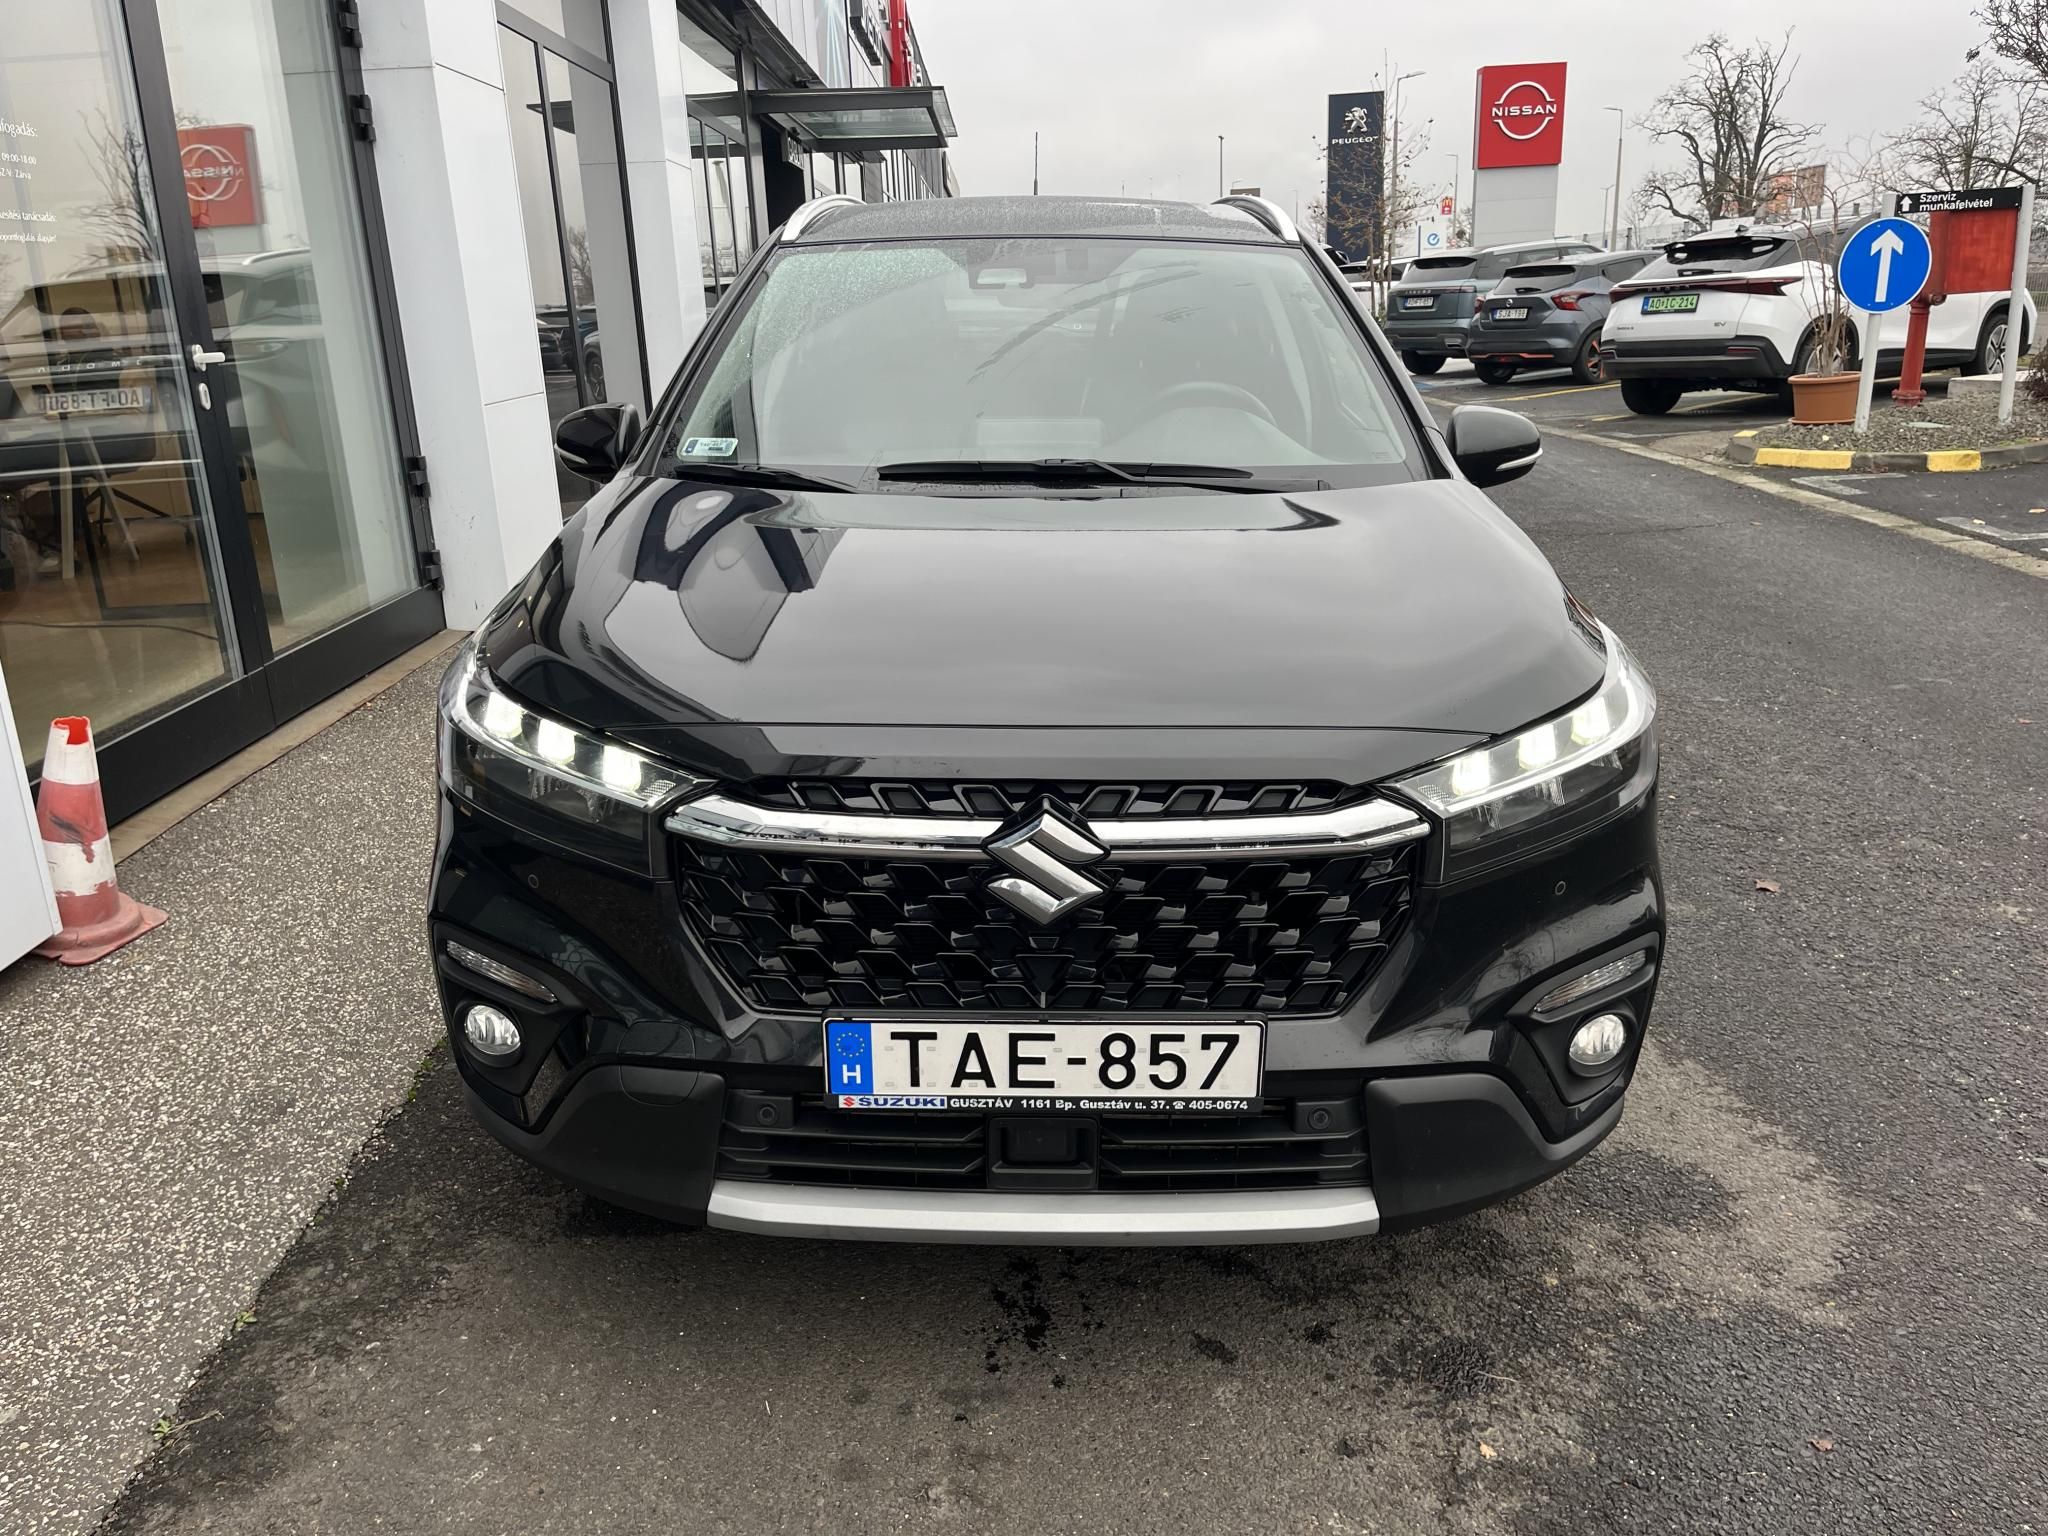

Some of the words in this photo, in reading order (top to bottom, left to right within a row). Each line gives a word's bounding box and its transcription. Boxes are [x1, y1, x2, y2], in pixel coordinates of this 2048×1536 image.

[1491, 104, 1557, 117] NISSAN
[1331, 136, 1379, 145] PEUGEOT
[1920, 191, 1957, 203] Szerviz
[1919, 198, 1993, 212] munkafelvétel
[890, 1031, 1240, 1090] TAE-857
[842, 1064, 861, 1084] H
[858, 1096, 945, 1107] SUZUKI
[950, 1096, 1013, 1108] GUSZTÁV
[1020, 1099, 1050, 1109] 1161
[1055, 1099, 1076, 1111] Bp.
[1079, 1098, 1131, 1110] Gusztáv
[1134, 1101, 1147, 1110] u.
[1150, 1100, 1170, 1110] 37.
[1188, 1100, 1249, 1110] 405-0674
